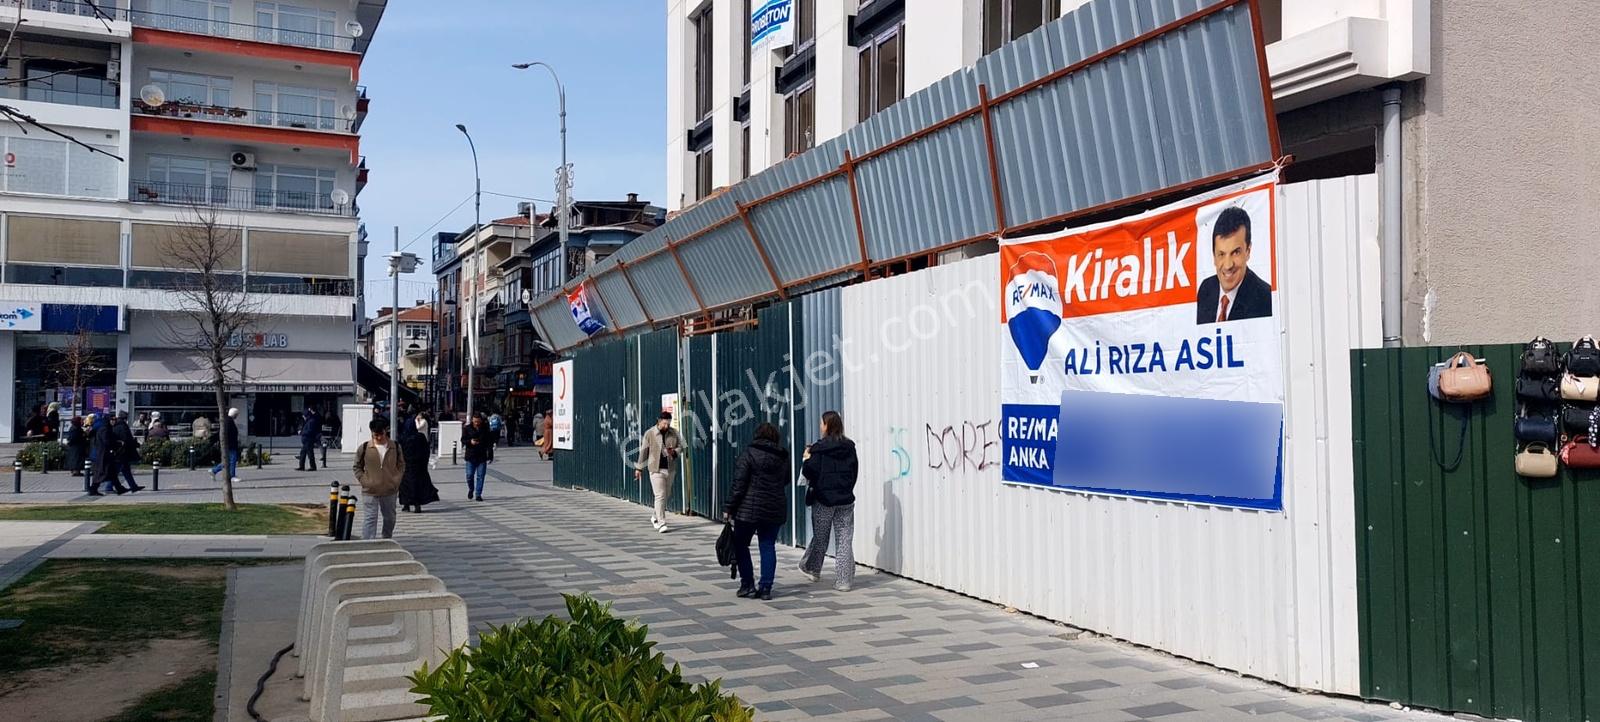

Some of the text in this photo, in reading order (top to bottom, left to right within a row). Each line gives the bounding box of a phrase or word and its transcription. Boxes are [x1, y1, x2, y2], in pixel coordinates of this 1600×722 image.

[1064, 231, 1191, 304] Kiralık
[1012, 282, 1055, 306] RE/MAX
[1065, 328, 1245, 375] ALİ RIZA ASİL
[1008, 416, 1059, 442] RE/MA
[1008, 446, 1050, 470] ANKA
